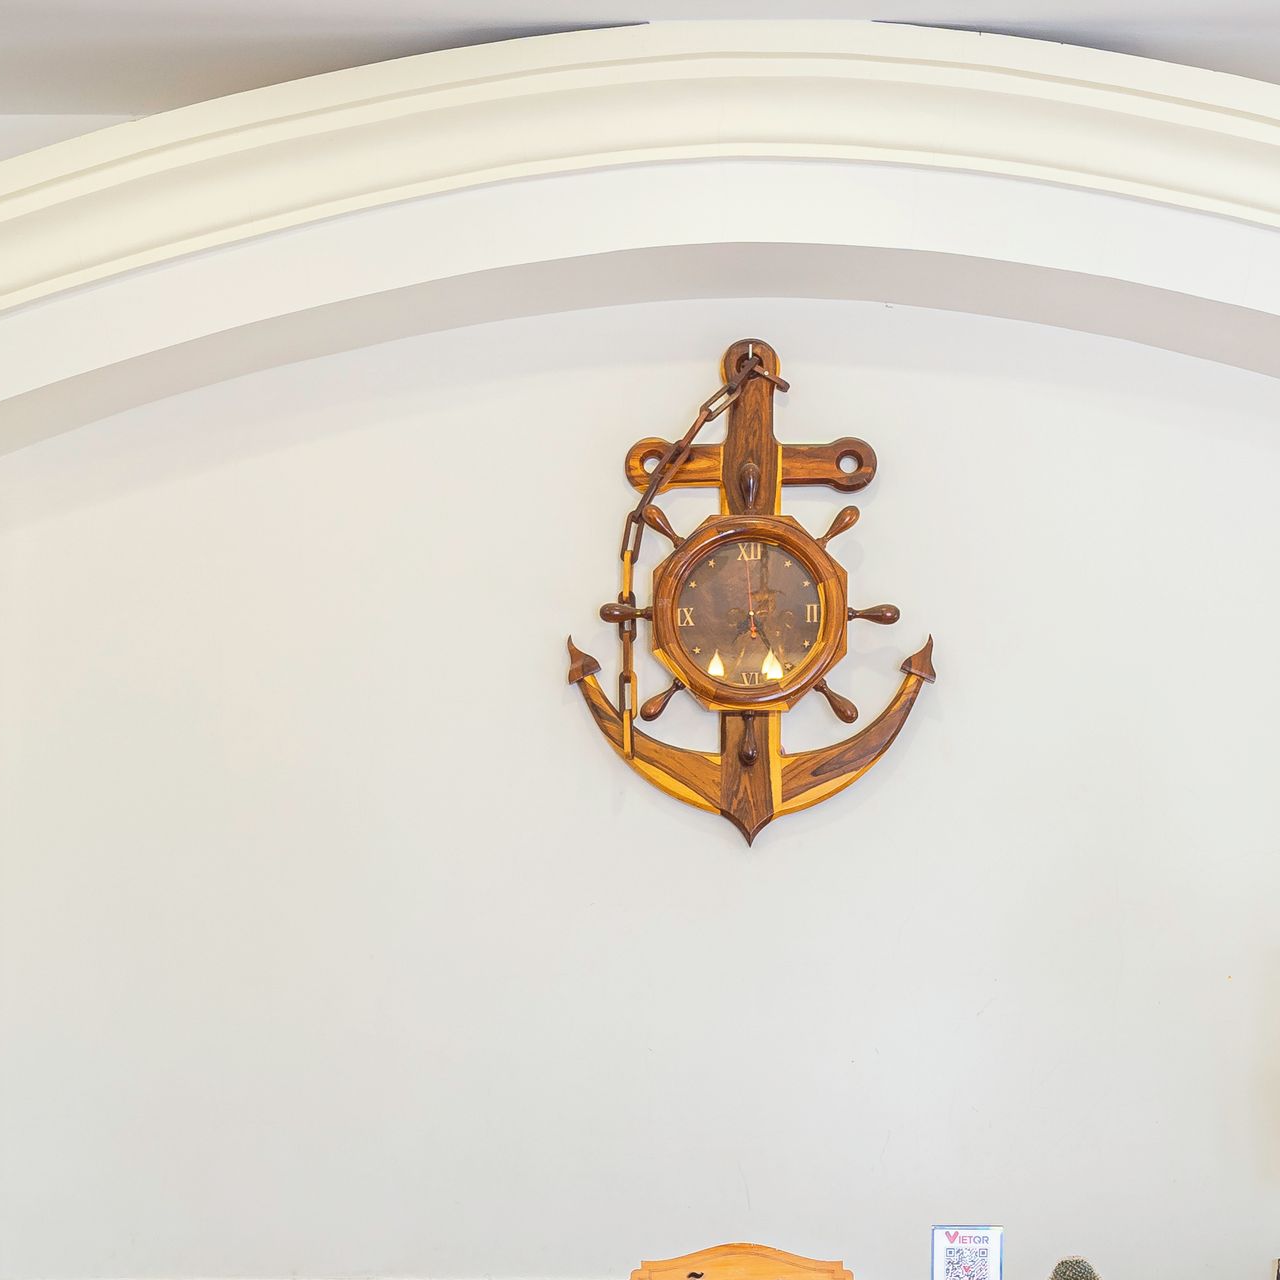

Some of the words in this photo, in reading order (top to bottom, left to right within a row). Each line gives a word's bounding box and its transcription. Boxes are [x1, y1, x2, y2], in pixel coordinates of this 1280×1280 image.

[737, 542, 761, 561] XII
[677, 607, 695, 627] IX
[741, 672, 759, 685] VI
[945, 1231, 989, 1244] VIETQR
